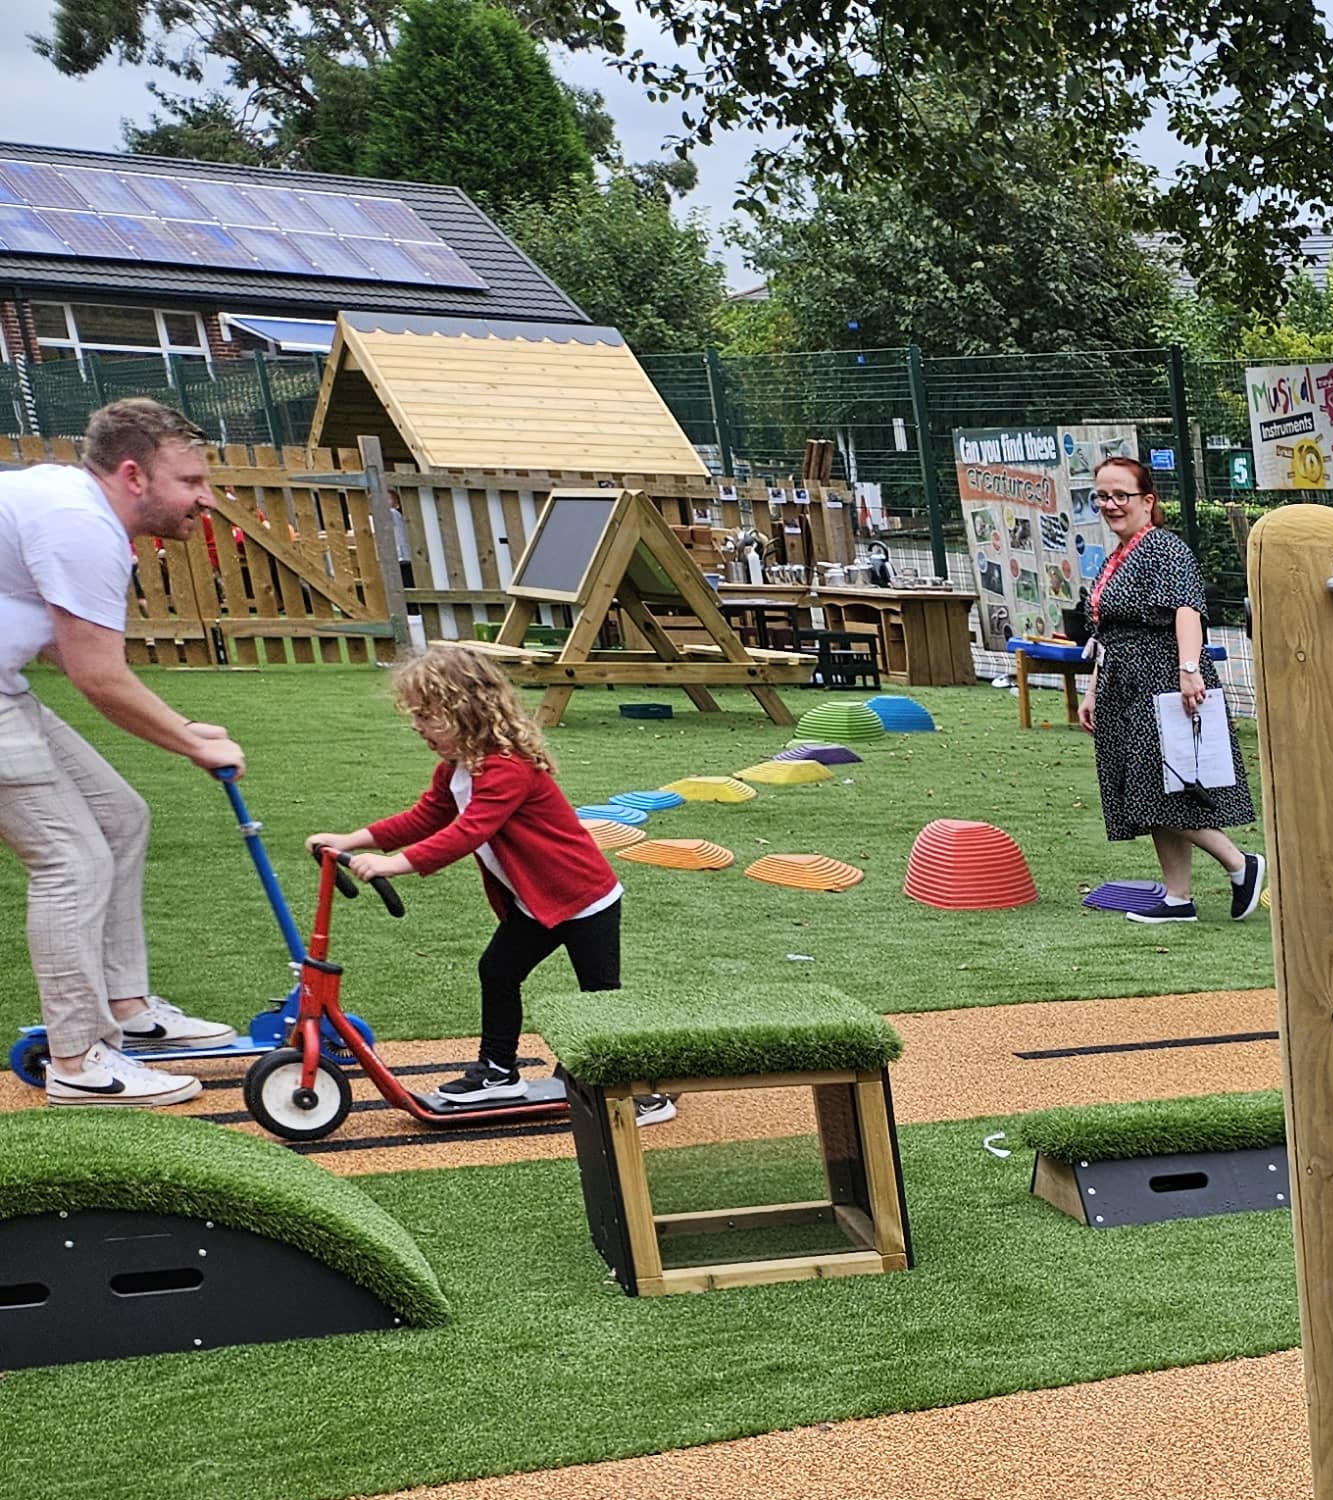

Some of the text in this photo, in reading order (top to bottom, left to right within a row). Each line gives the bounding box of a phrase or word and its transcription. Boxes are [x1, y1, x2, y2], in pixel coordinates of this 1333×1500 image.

[1251, 367, 1315, 415] Musical
[1261, 416, 1313, 439] Instruments
[960, 431, 1056, 466] Can you find these
[967, 467, 1050, 505] creatures?
[1233, 457, 1248, 484] 5
